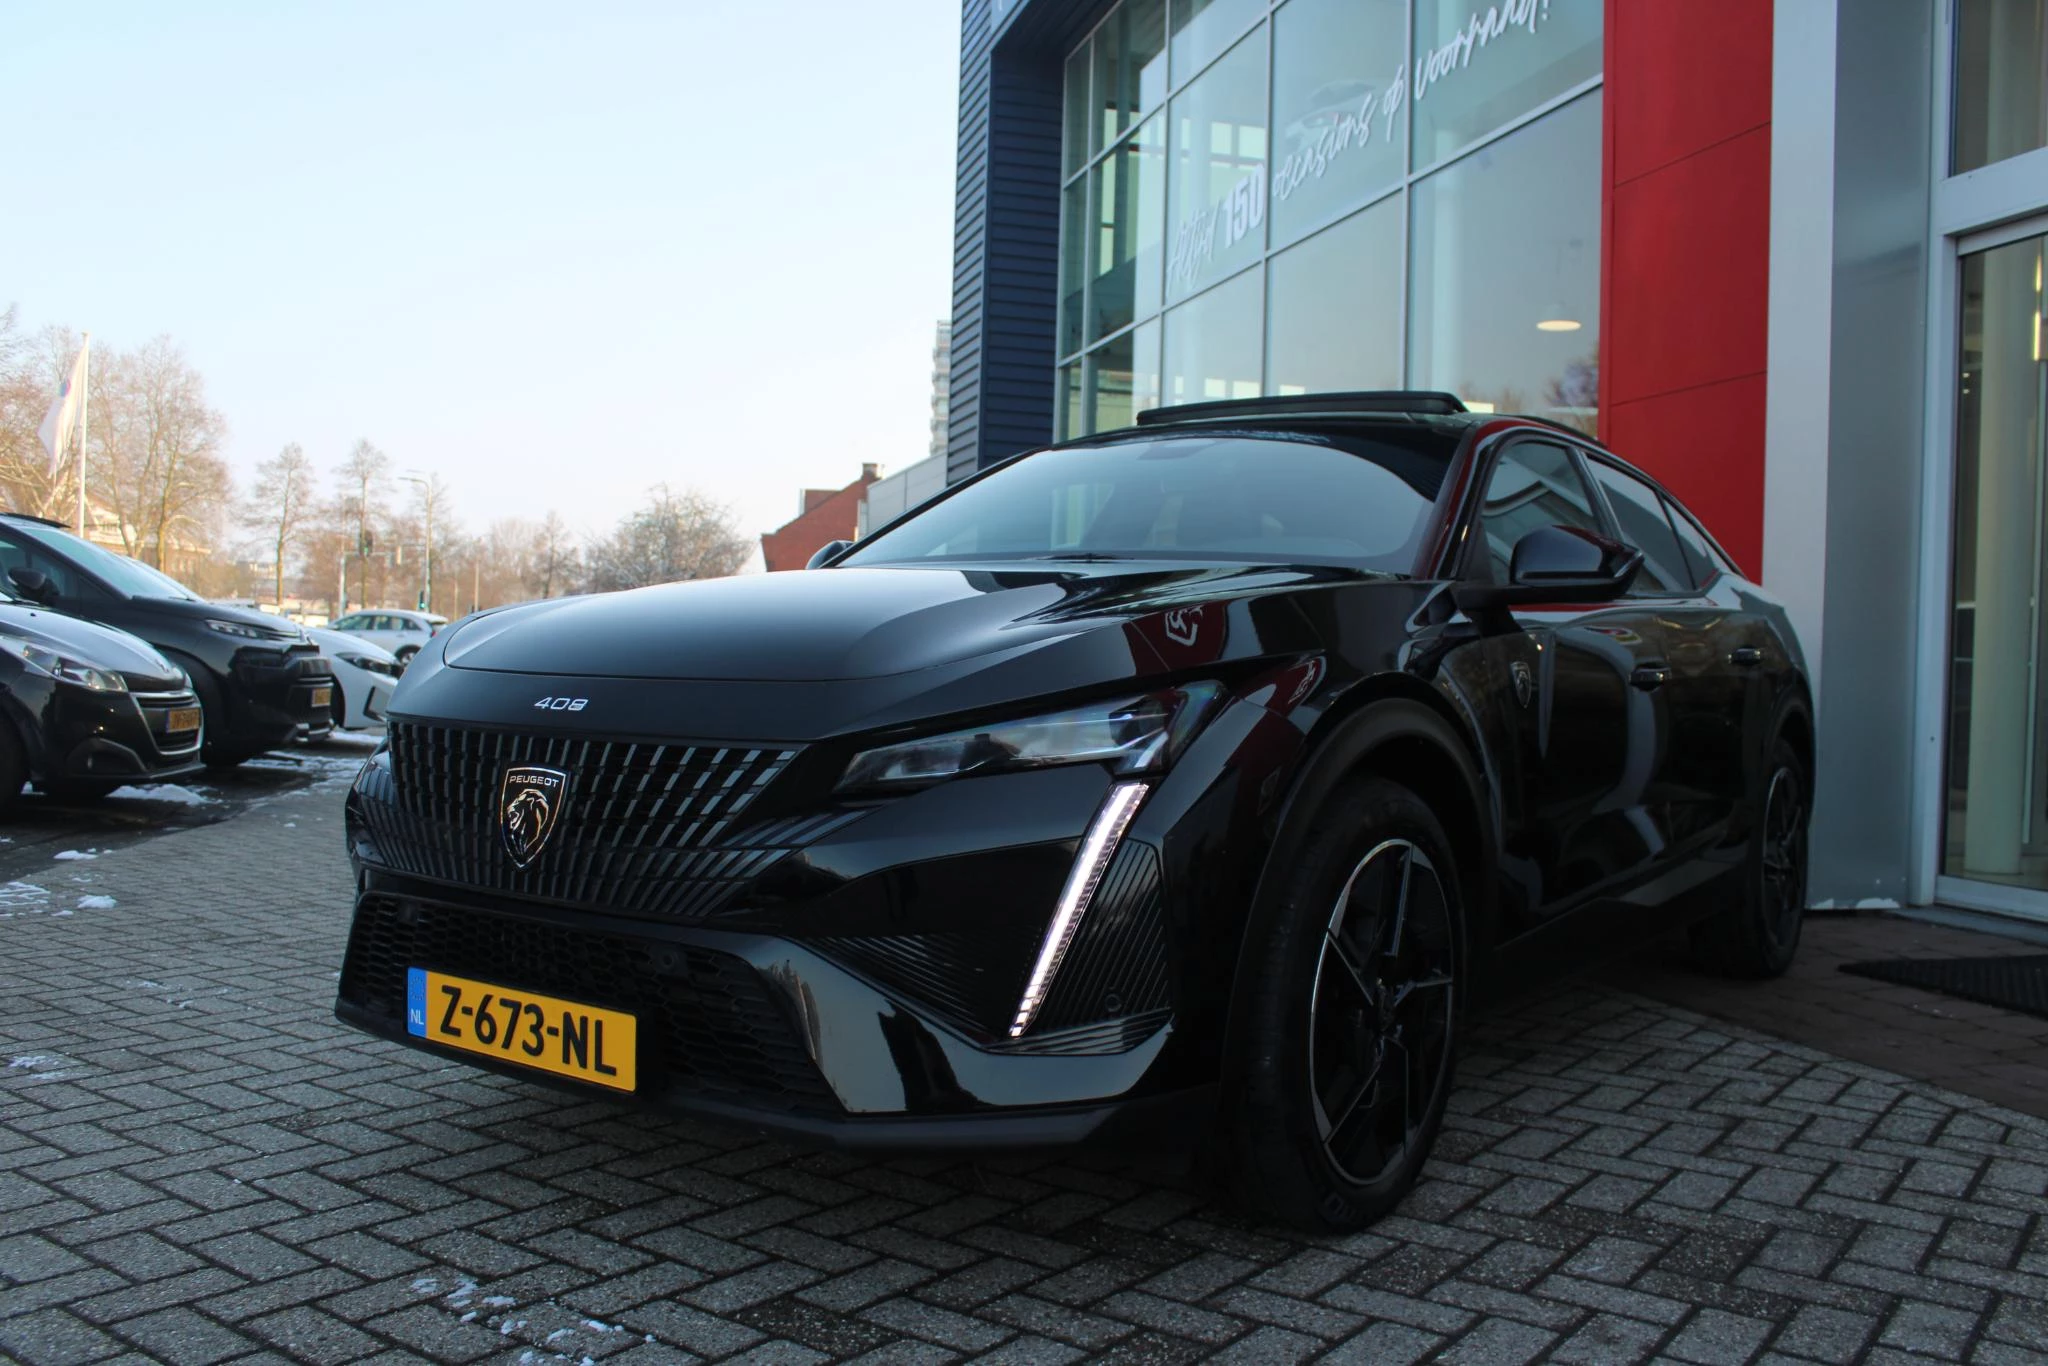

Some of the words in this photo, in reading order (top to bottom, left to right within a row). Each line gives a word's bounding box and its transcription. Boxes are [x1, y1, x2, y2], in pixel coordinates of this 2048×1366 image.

[1223, 163, 1265, 249] 150
[1272, 92, 1377, 200] occasions
[1382, 63, 1406, 143] op
[534, 696, 589, 711] 408
[509, 774, 559, 787] PEUGEOT
[410, 1007, 425, 1026] NL
[440, 985, 617, 1077] Z-673-NL
